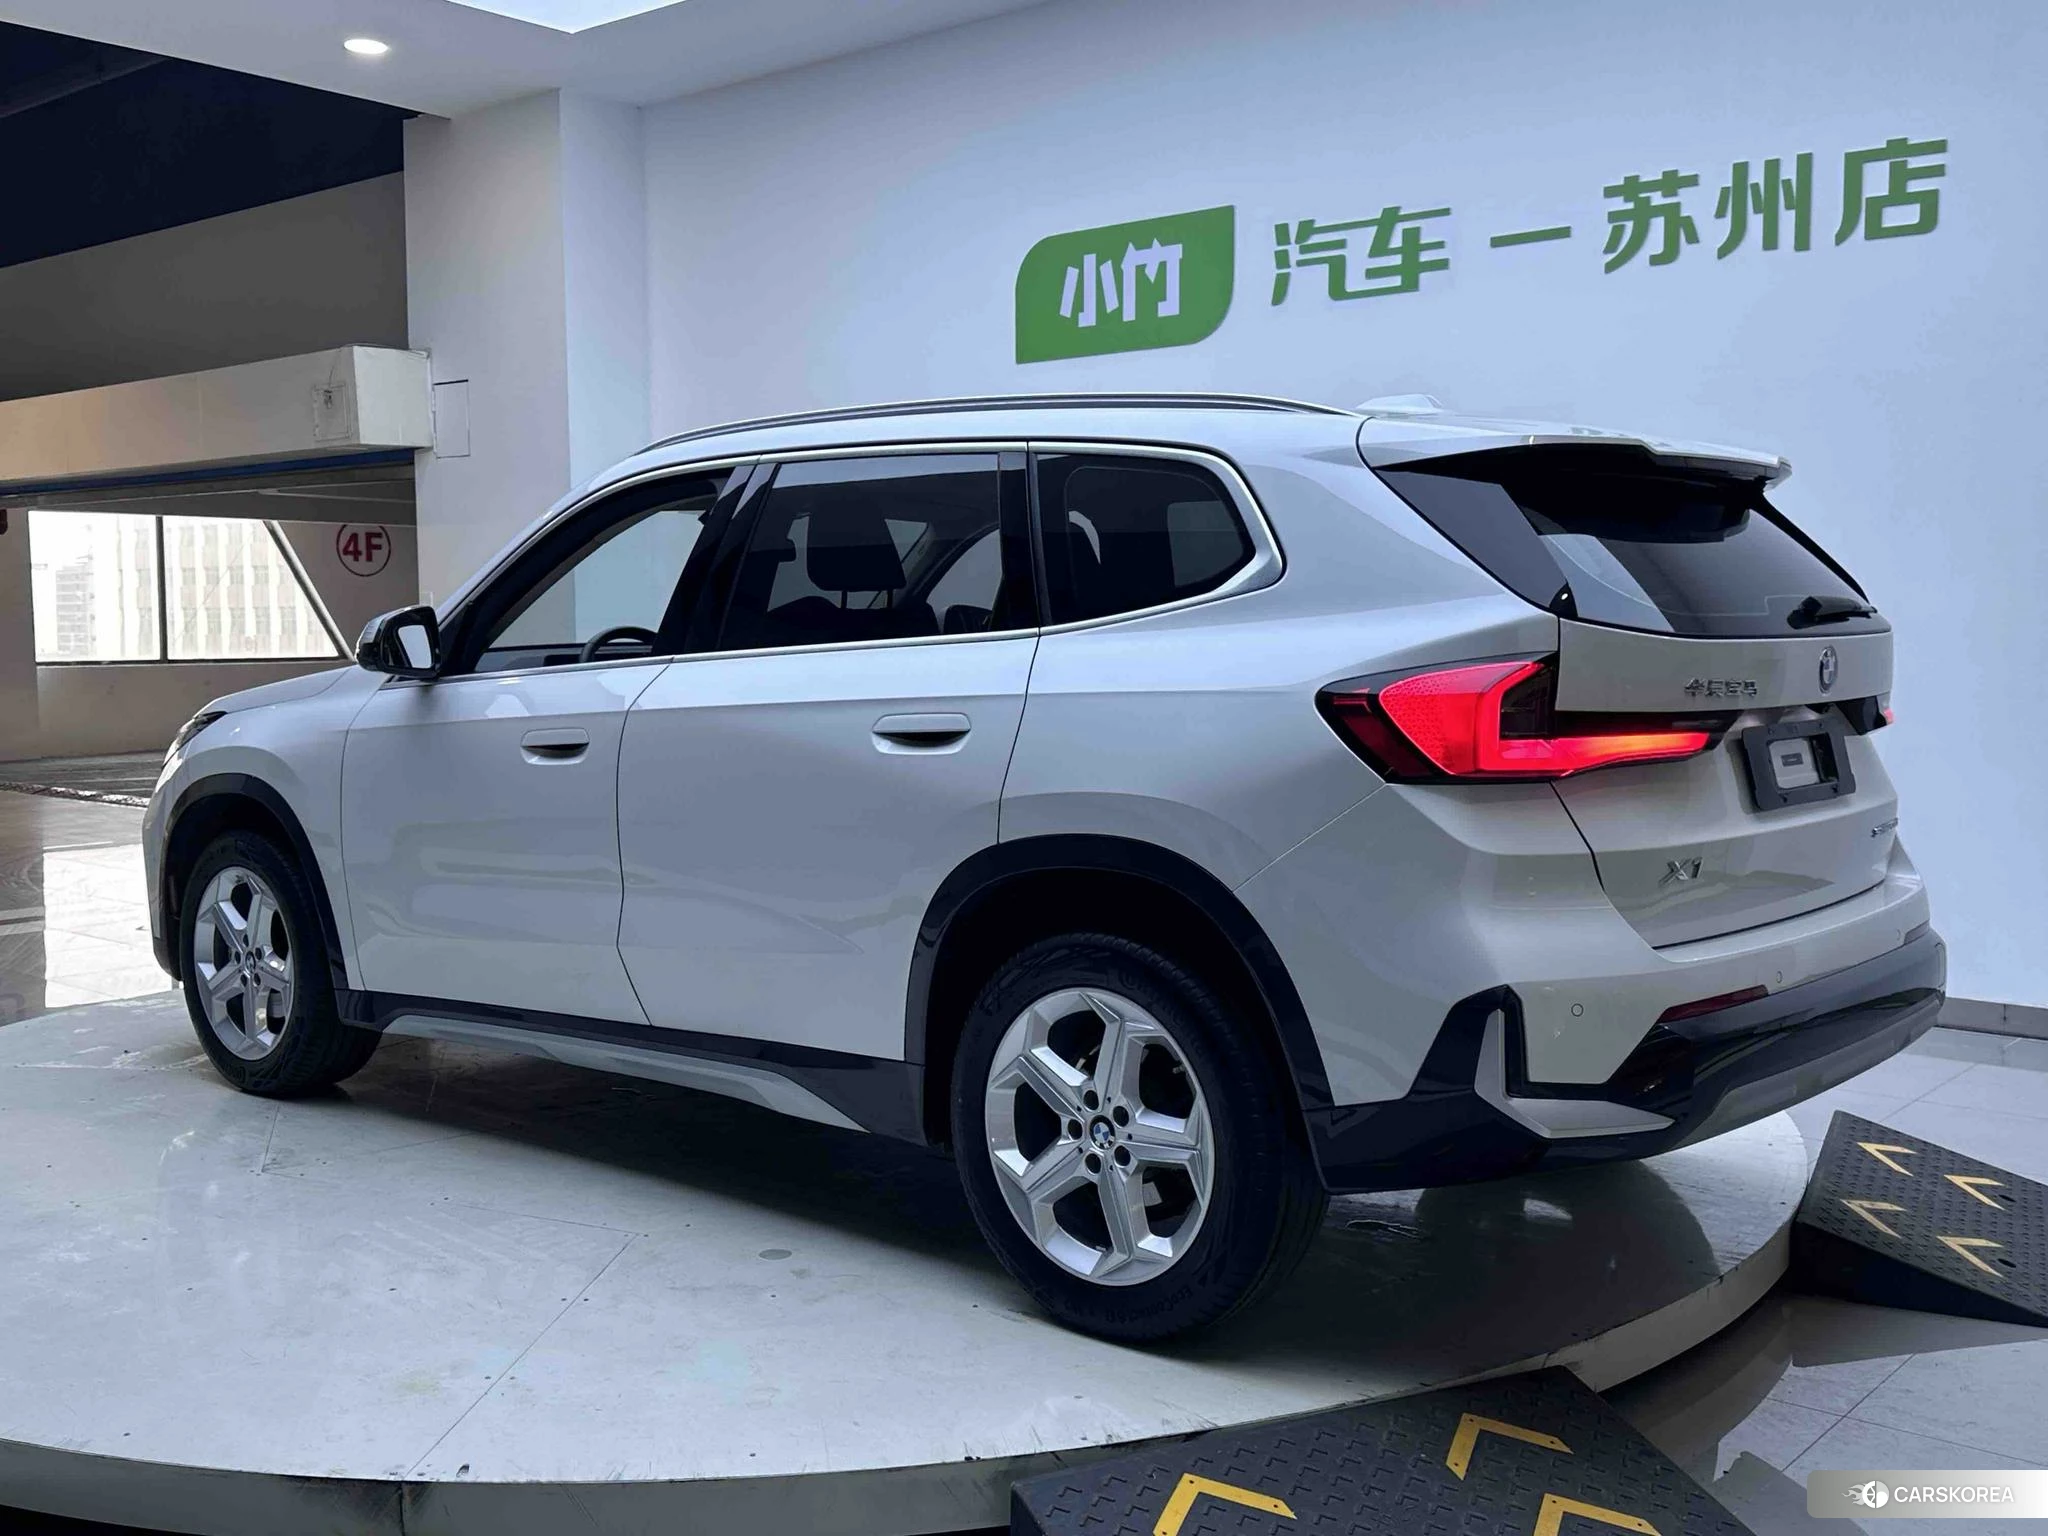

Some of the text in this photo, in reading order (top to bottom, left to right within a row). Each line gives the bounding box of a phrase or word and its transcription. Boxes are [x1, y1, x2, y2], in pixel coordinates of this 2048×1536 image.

[1060, 241, 1182, 327] 小竹
[342, 532, 383, 562] 4F
[1658, 856, 1703, 886] X1
